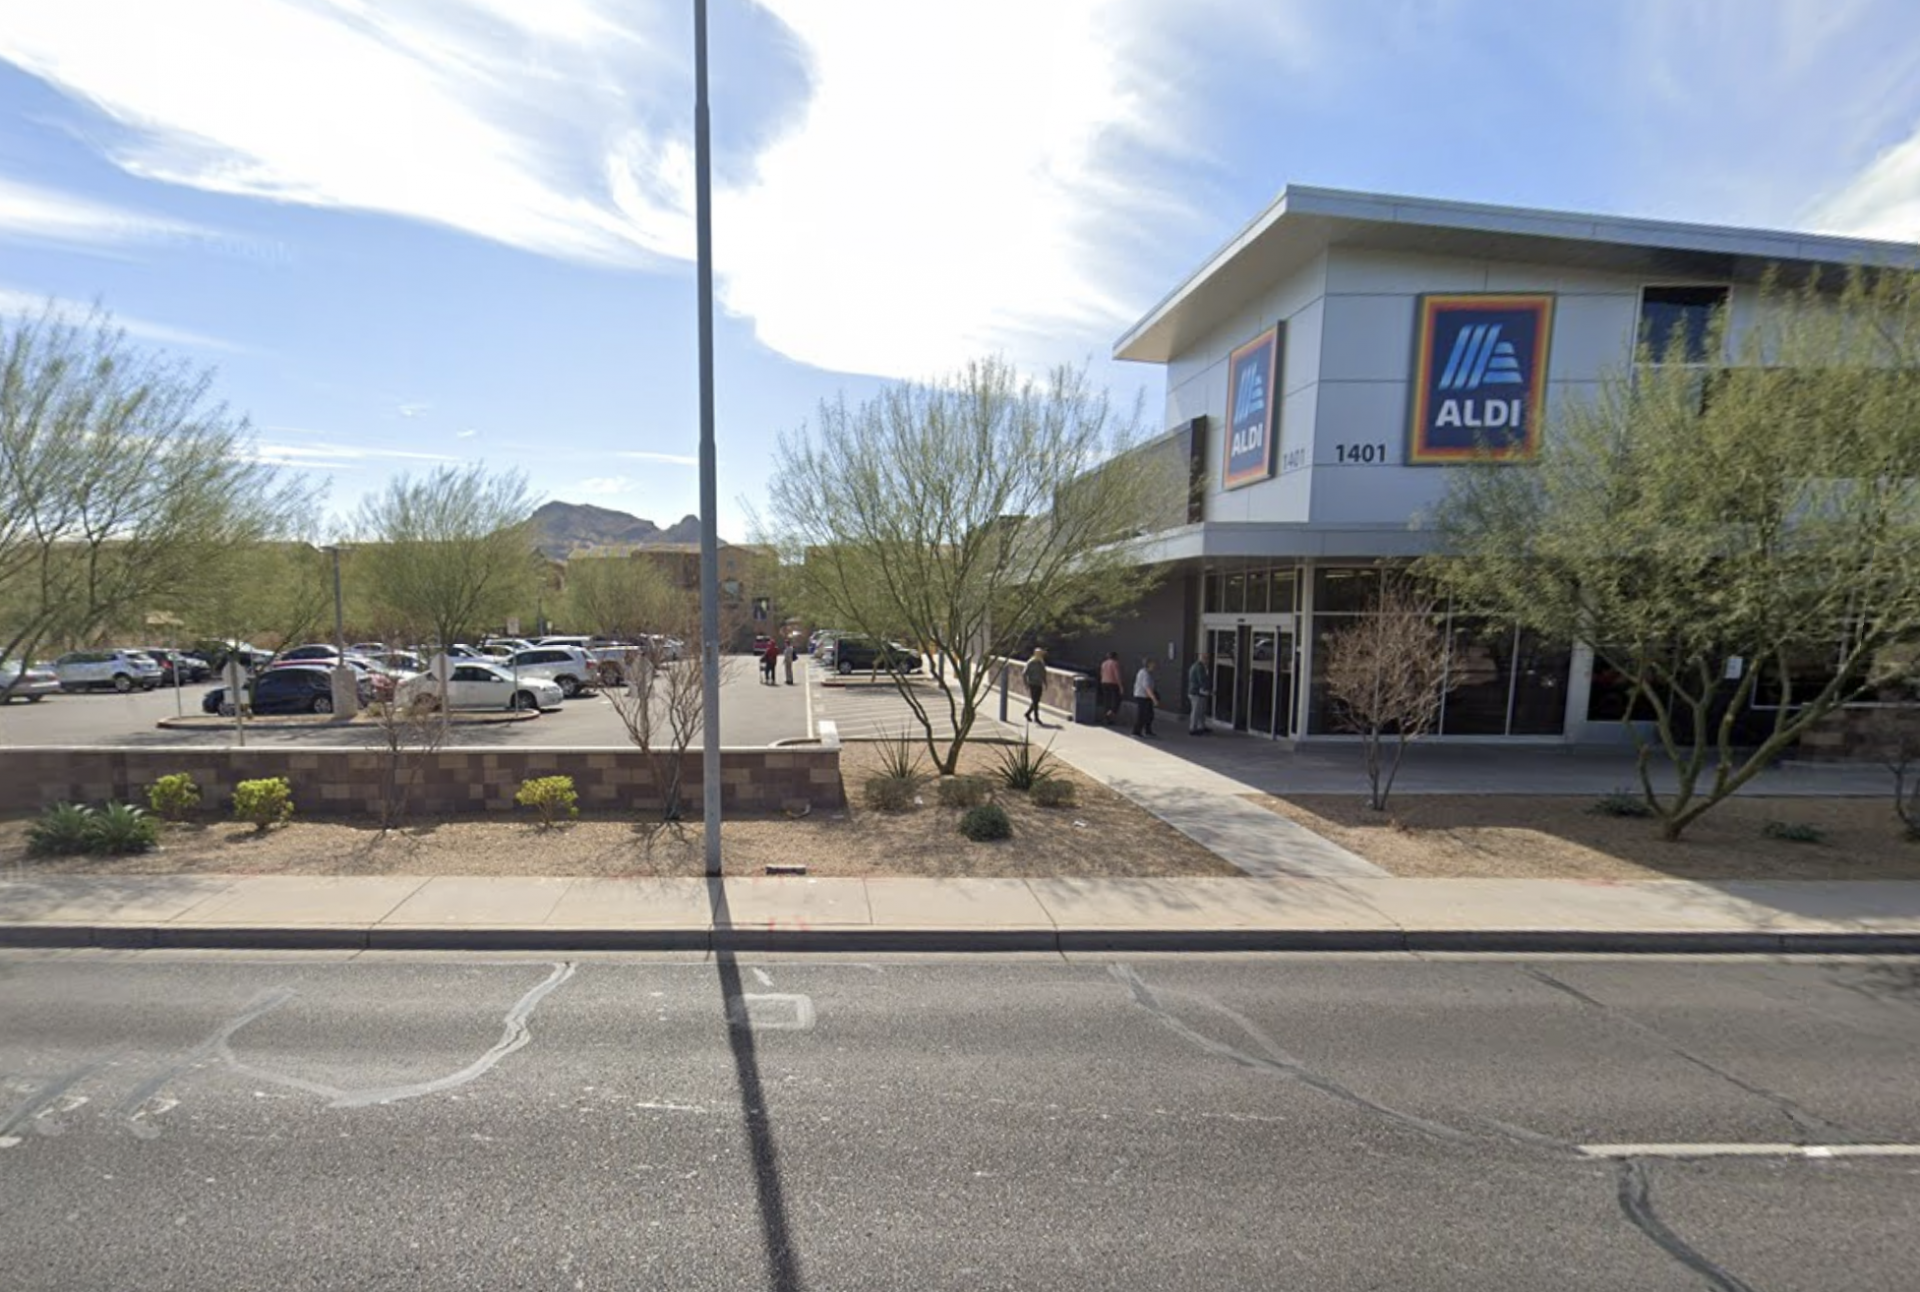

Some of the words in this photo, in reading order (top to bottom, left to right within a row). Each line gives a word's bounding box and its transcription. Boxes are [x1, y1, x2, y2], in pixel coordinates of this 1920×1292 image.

[1435, 399, 1522, 427] ALDI
[1232, 423, 1263, 457] ALDI
[1336, 443, 1386, 463] 1401
